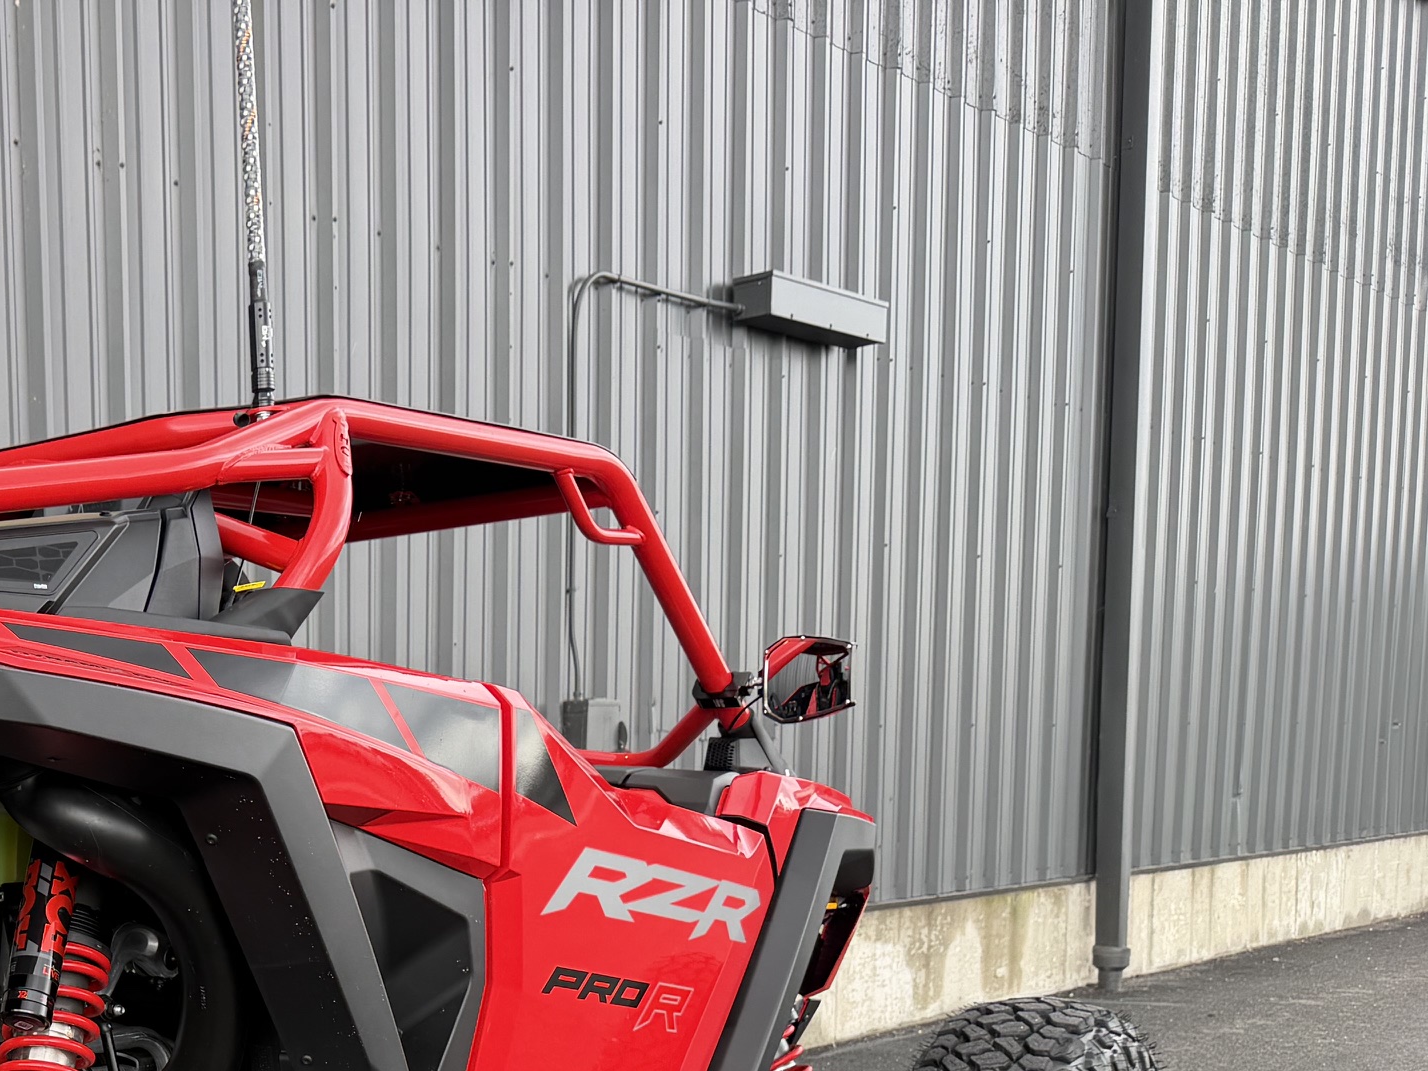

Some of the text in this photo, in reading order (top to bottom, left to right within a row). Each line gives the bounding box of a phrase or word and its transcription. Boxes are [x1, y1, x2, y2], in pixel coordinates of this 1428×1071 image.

[41, 861, 78, 956] FOX
[540, 847, 761, 943] RZR
[541, 966, 694, 1033] PRO R
